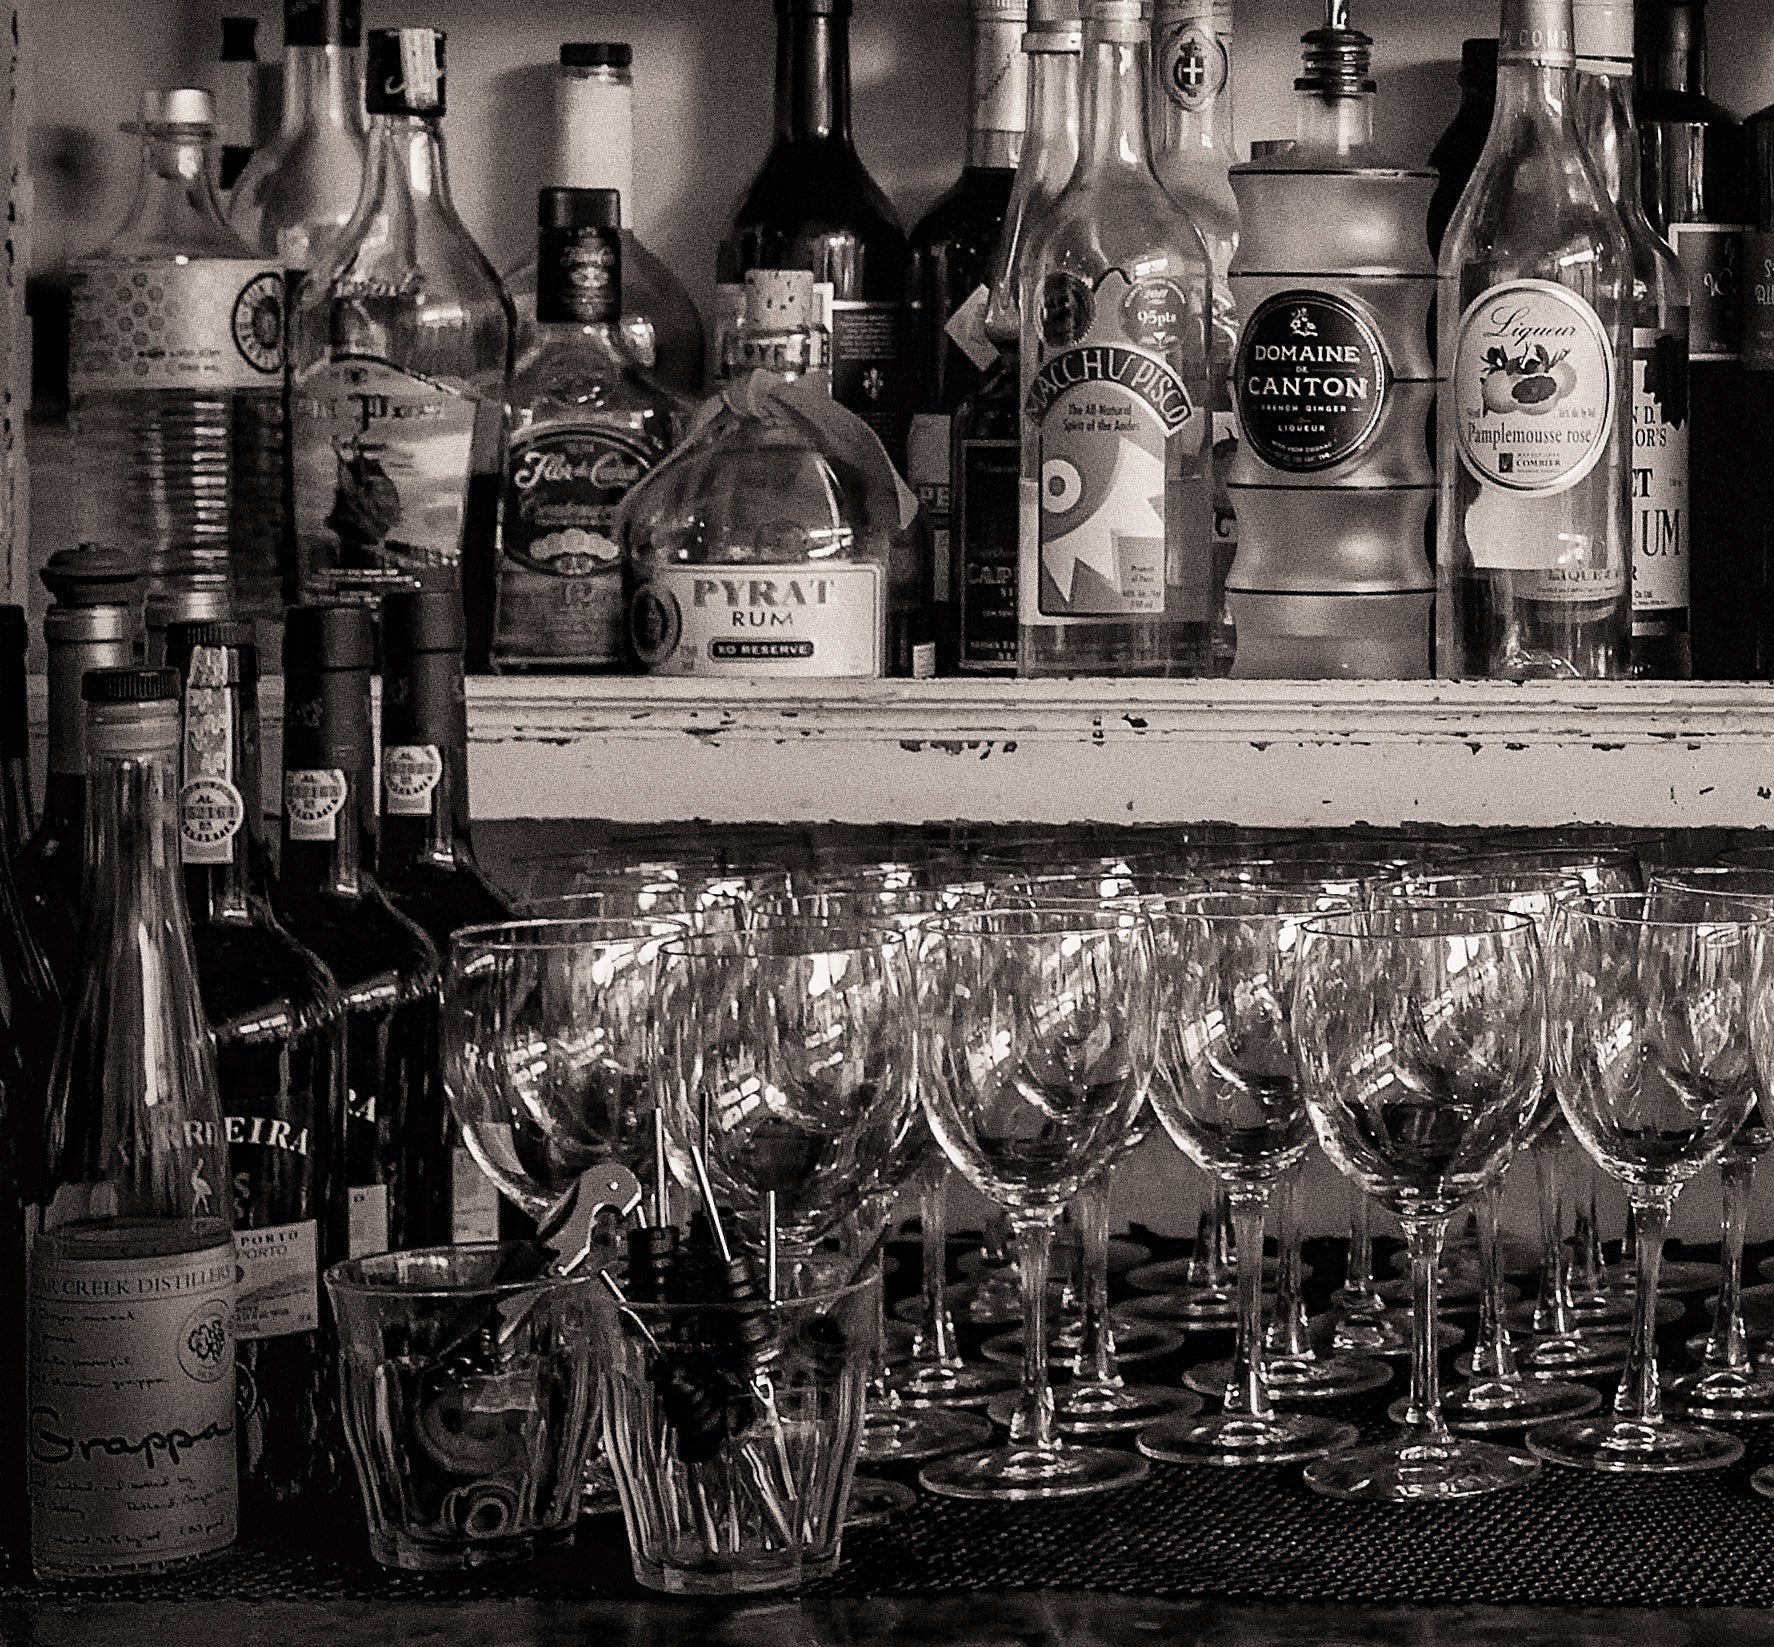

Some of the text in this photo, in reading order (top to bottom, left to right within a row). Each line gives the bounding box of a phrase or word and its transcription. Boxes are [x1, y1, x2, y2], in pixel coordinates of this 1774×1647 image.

[1485, 306, 1576, 346] Liqueur
[1255, 345, 1361, 363] DOMAINE
[1132, 363, 1189, 422] PISCO
[1249, 377, 1368, 399] CANTON
[1467, 421, 1562, 450] Pamplemousse
[693, 580, 834, 606] PYRAT
[733, 612, 793, 626] RUM
[240, 1230, 299, 1247] PORTO
[55, 1276, 130, 1296] CREEK
[32, 1406, 234, 1471] Grappa
